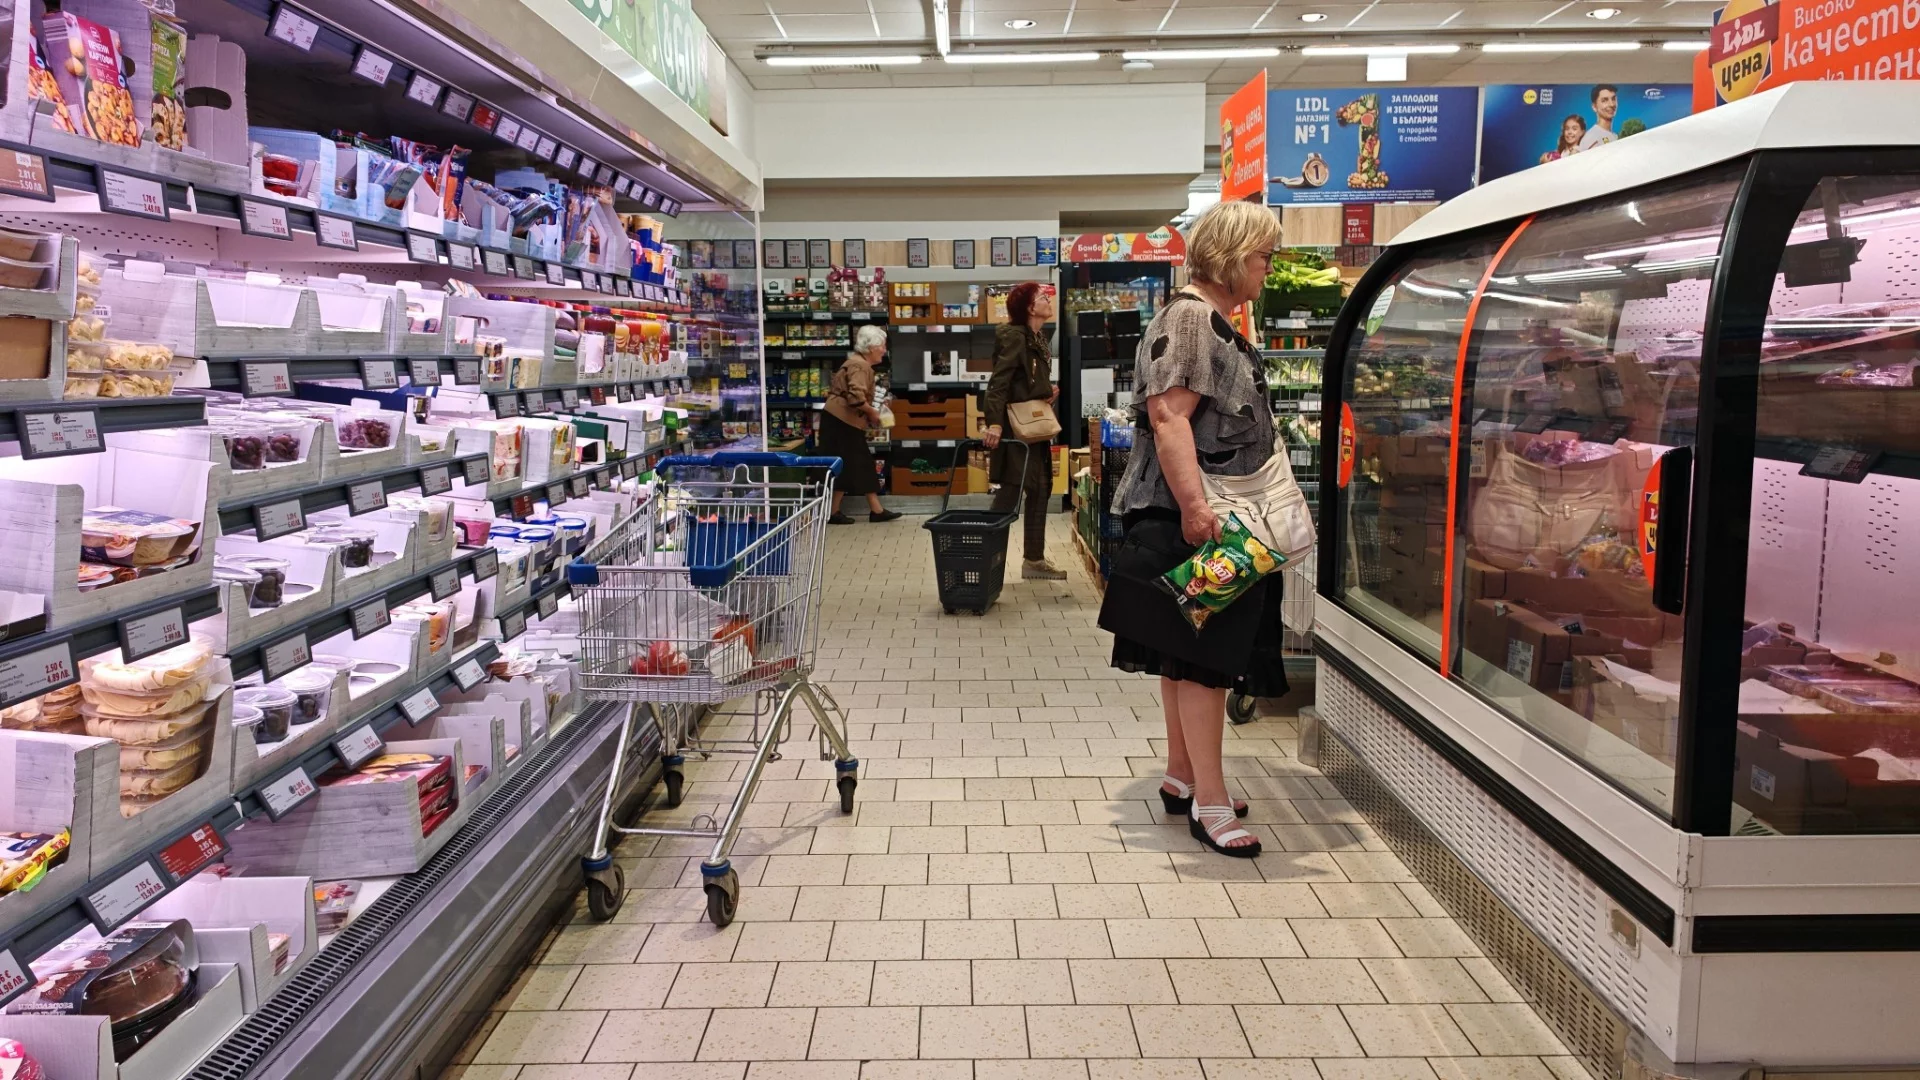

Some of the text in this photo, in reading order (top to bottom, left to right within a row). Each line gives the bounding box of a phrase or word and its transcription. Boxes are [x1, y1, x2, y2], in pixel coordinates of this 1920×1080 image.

[88, 50, 115, 66] КАРТОФИ
[1854, 47, 1920, 80] цен
[1721, 52, 1763, 92] цена
[1391, 94, 1438, 104] ЗА ПЛОДОВЕ
[1296, 97, 1330, 112] LIDL
[1387, 105, 1438, 115] И ЗЕЛЕНЧУЦИ
[1295, 114, 1330, 123] МАГАЗИН
[1392, 115, 1438, 124] В БЪЛГАРИЯ
[1321, 125, 1329, 144] 1
[1406, 126, 1437, 135] продажби
[1404, 135, 1437, 143] стойност
[18, 169, 37, 181] 2.81 €
[19, 180, 33, 190] 5.50
[142, 194, 156, 204] 1.78 €
[163, 622, 176, 634] 1.53 €
[164, 633, 174, 643] 2.99
[45, 660, 63, 674] 2.50 €
[47, 672, 60, 683] 4.89
[135, 878, 151, 892] 7.15 €
[4, 969, 11, 979] €
